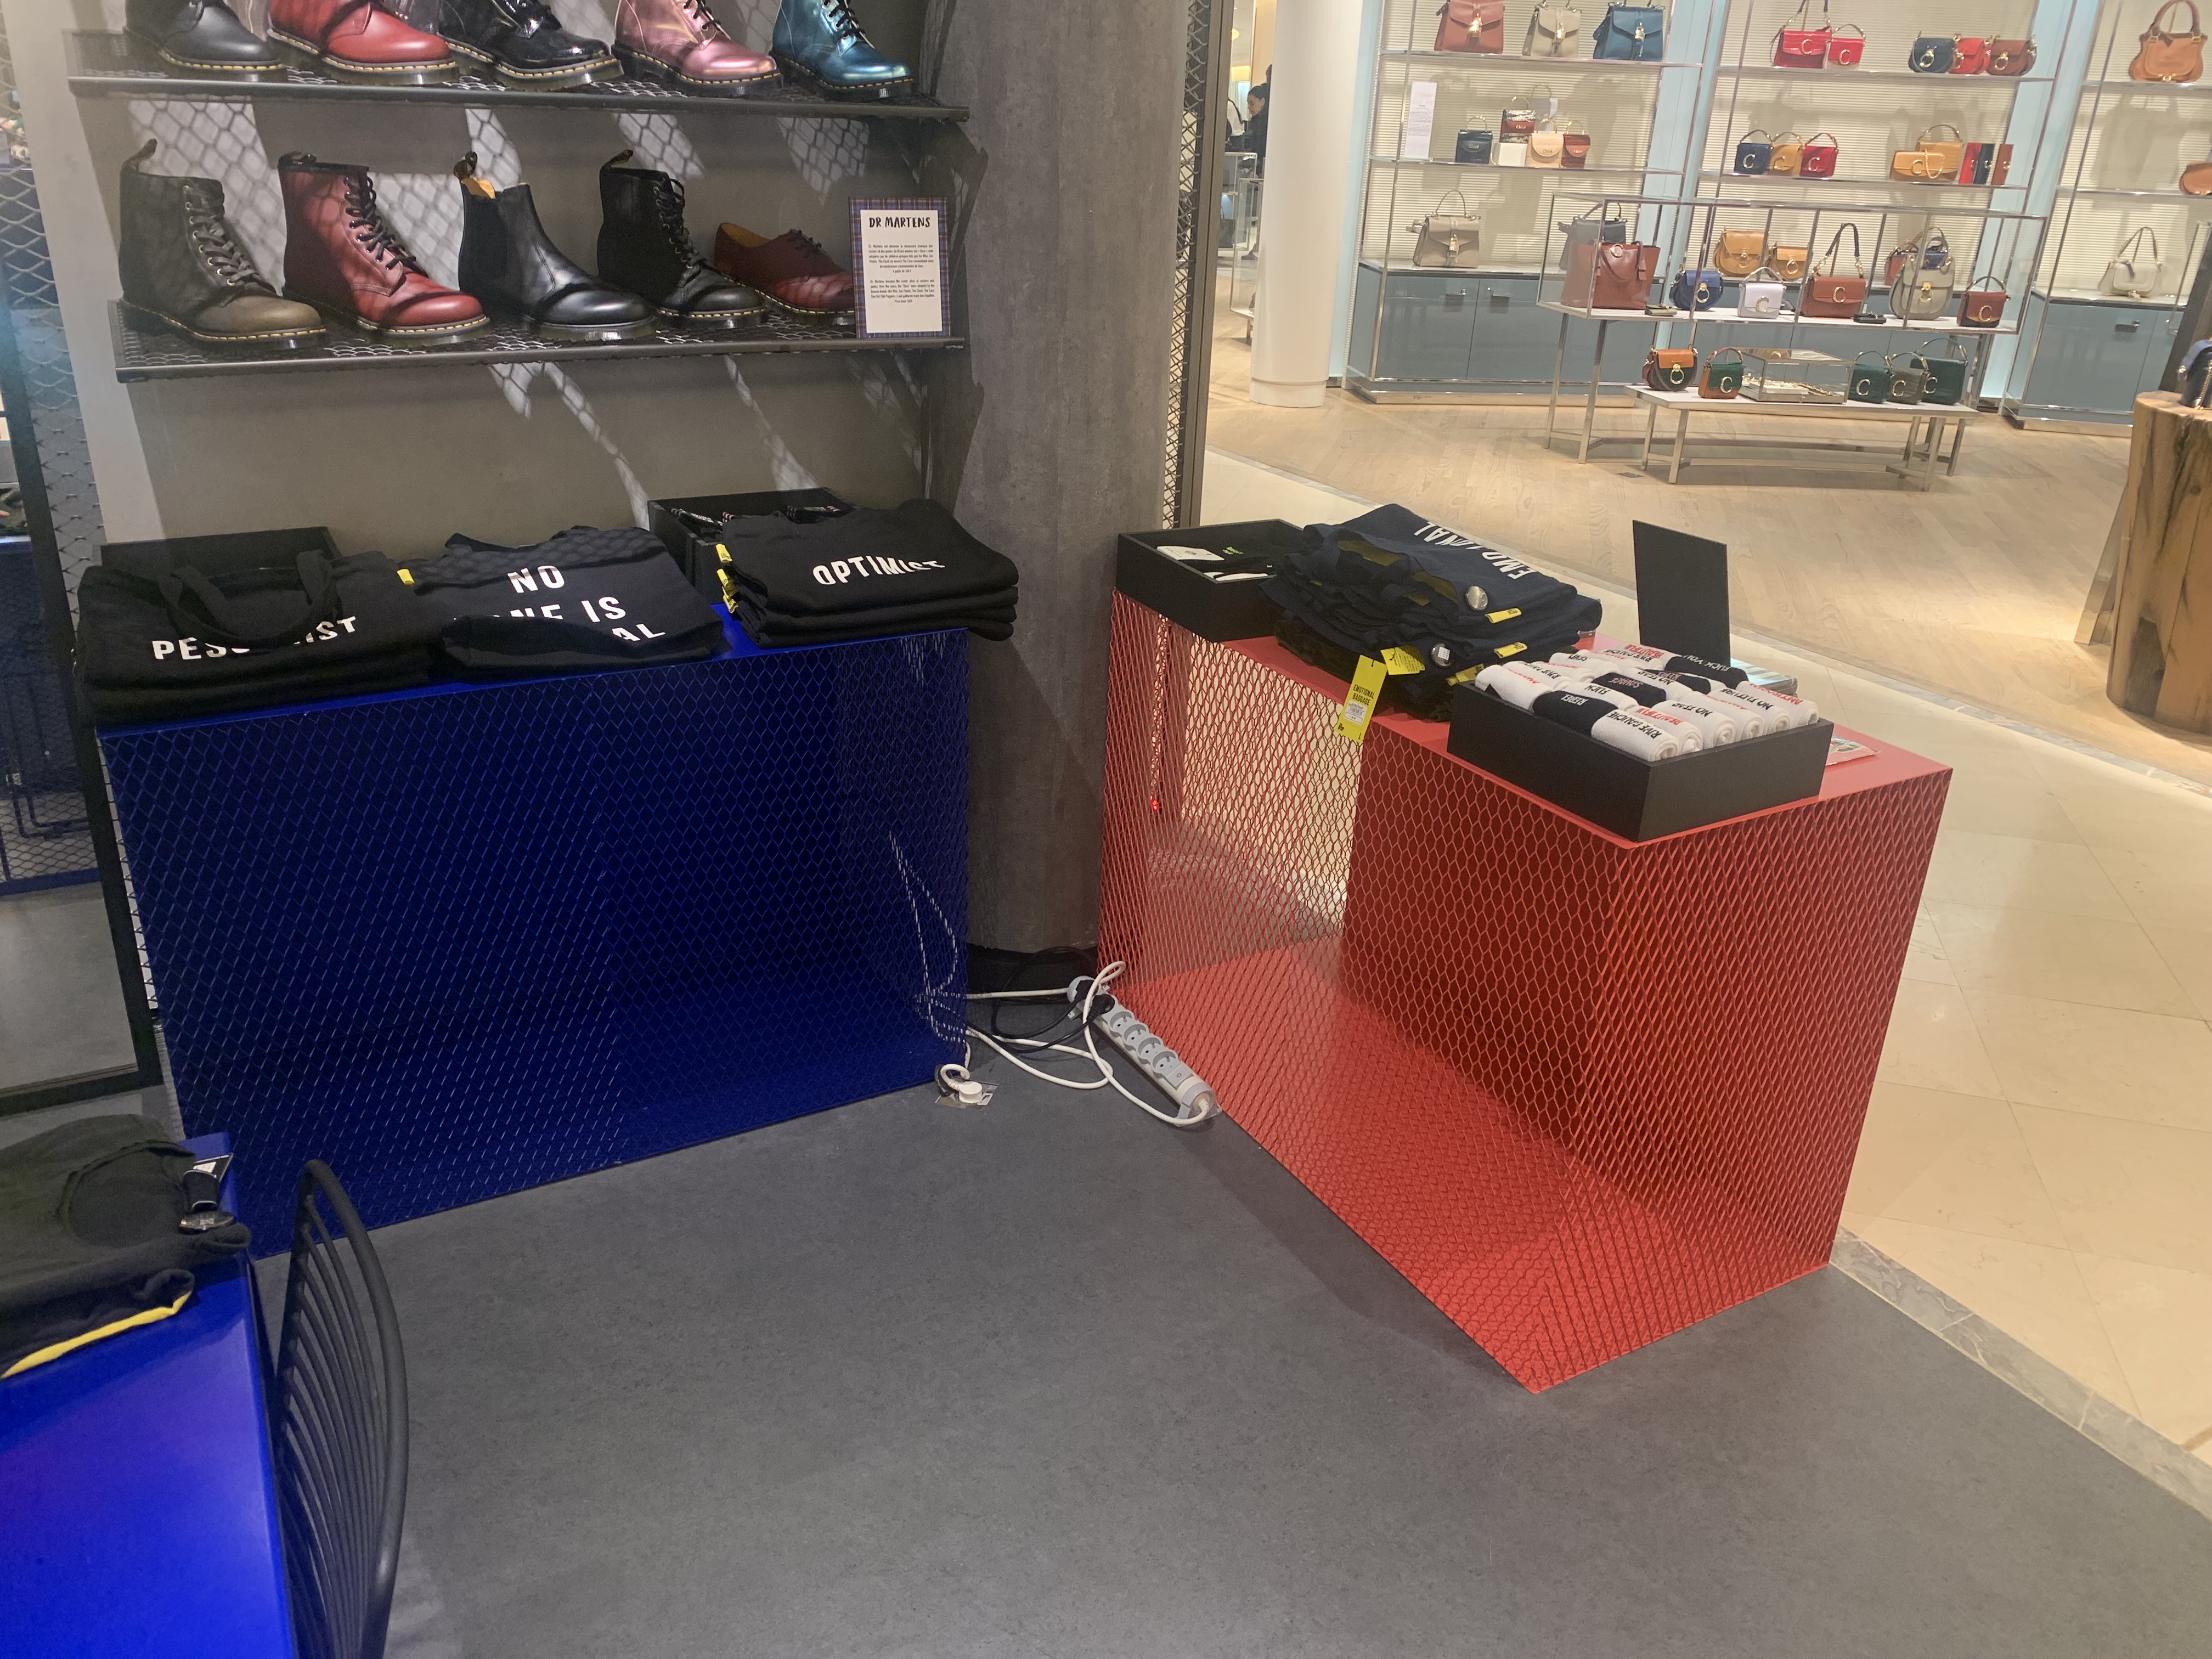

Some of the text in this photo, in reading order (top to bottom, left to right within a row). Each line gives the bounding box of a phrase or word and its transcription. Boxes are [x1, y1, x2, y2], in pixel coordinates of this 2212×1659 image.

[869, 216, 931, 228] DR MARTENS
[507, 565, 565, 593] NO
[581, 596, 626, 623] IS
[1703, 661, 1732, 672] FUCK
[1353, 684, 1374, 699] EMOTIONAL
[1352, 692, 1370, 706] BAGGAGE
[1757, 701, 1774, 710] NO
[1696, 707, 1714, 717] NO
[1606, 711, 1662, 739] RIVE GAUCHE
